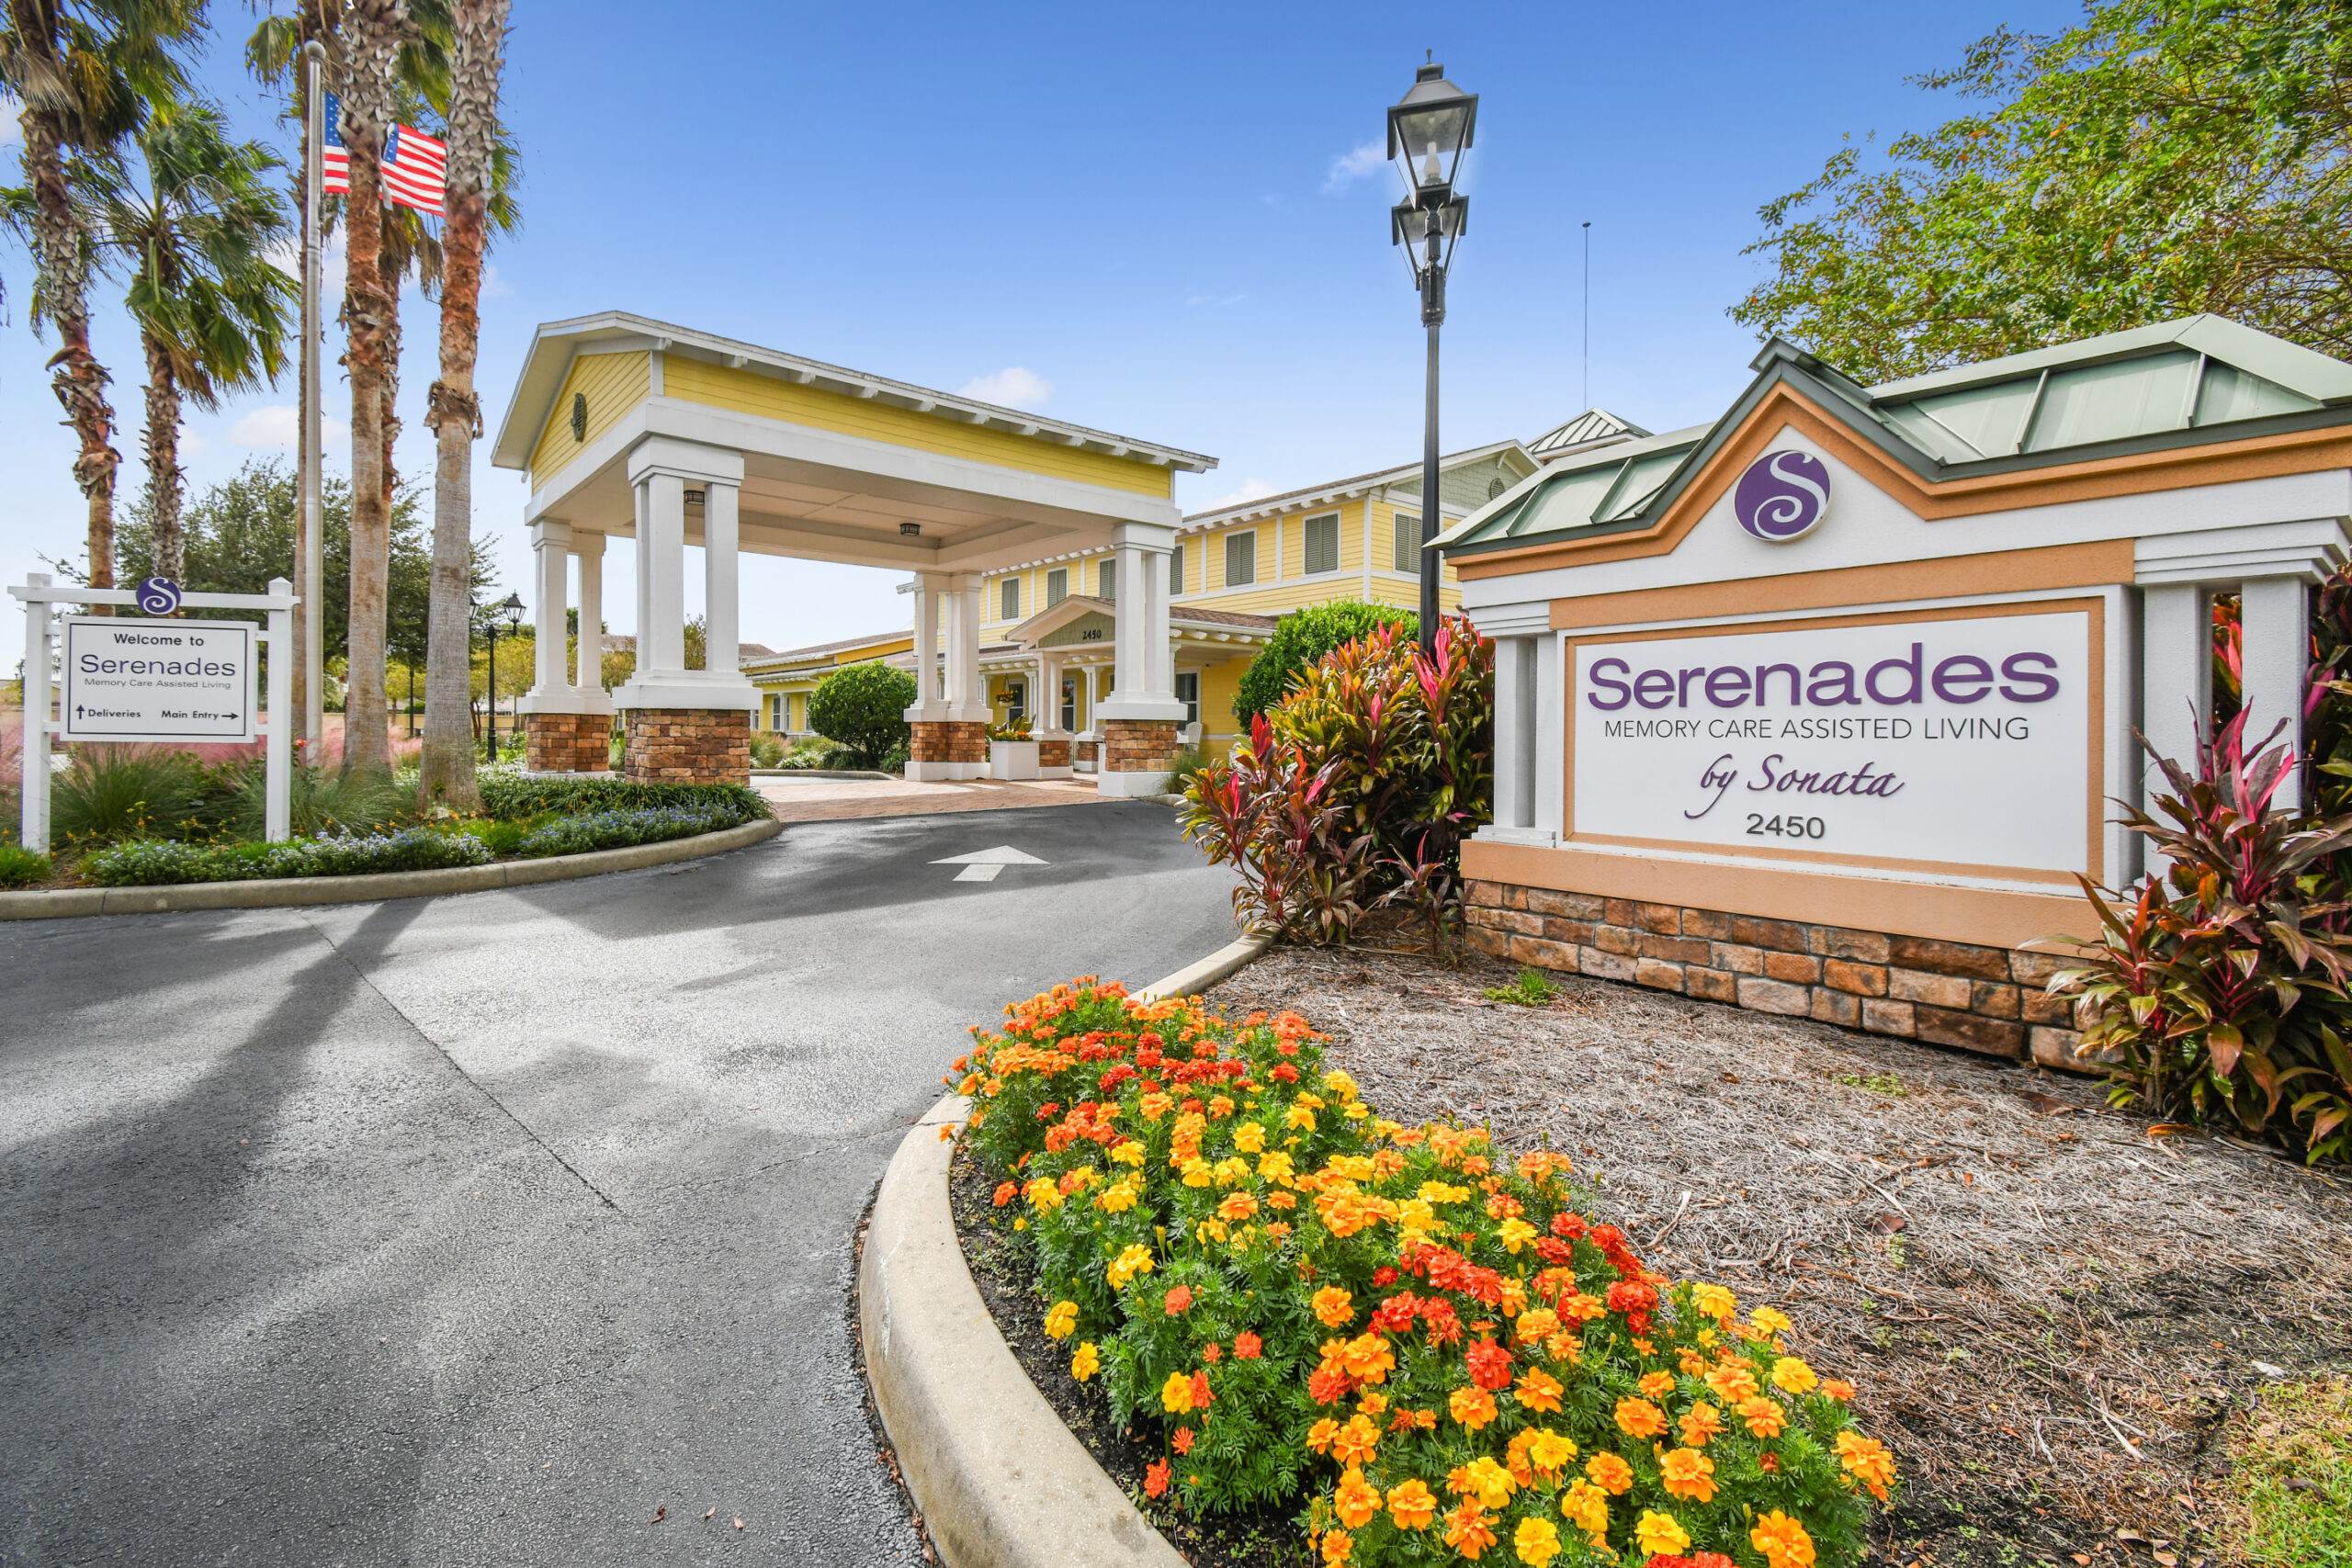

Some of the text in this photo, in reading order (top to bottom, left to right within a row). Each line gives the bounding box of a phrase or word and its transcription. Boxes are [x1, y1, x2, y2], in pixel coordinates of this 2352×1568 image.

[114, 633, 205, 647] Welcome to
[1082, 629, 1102, 639] 2450
[80, 654, 236, 676] Serenades
[85, 678, 231, 690] Memory Care Assisted Living
[1588, 642, 2061, 711] Serenades
[88, 708, 141, 718] Deliveries
[161, 710, 220, 722] Main Entry
[1604, 716, 2030, 740] MEMORY CARE ASSISTED LIVING
[1683, 753, 1905, 820] by Sonata
[1746, 813, 1826, 840] 2450
